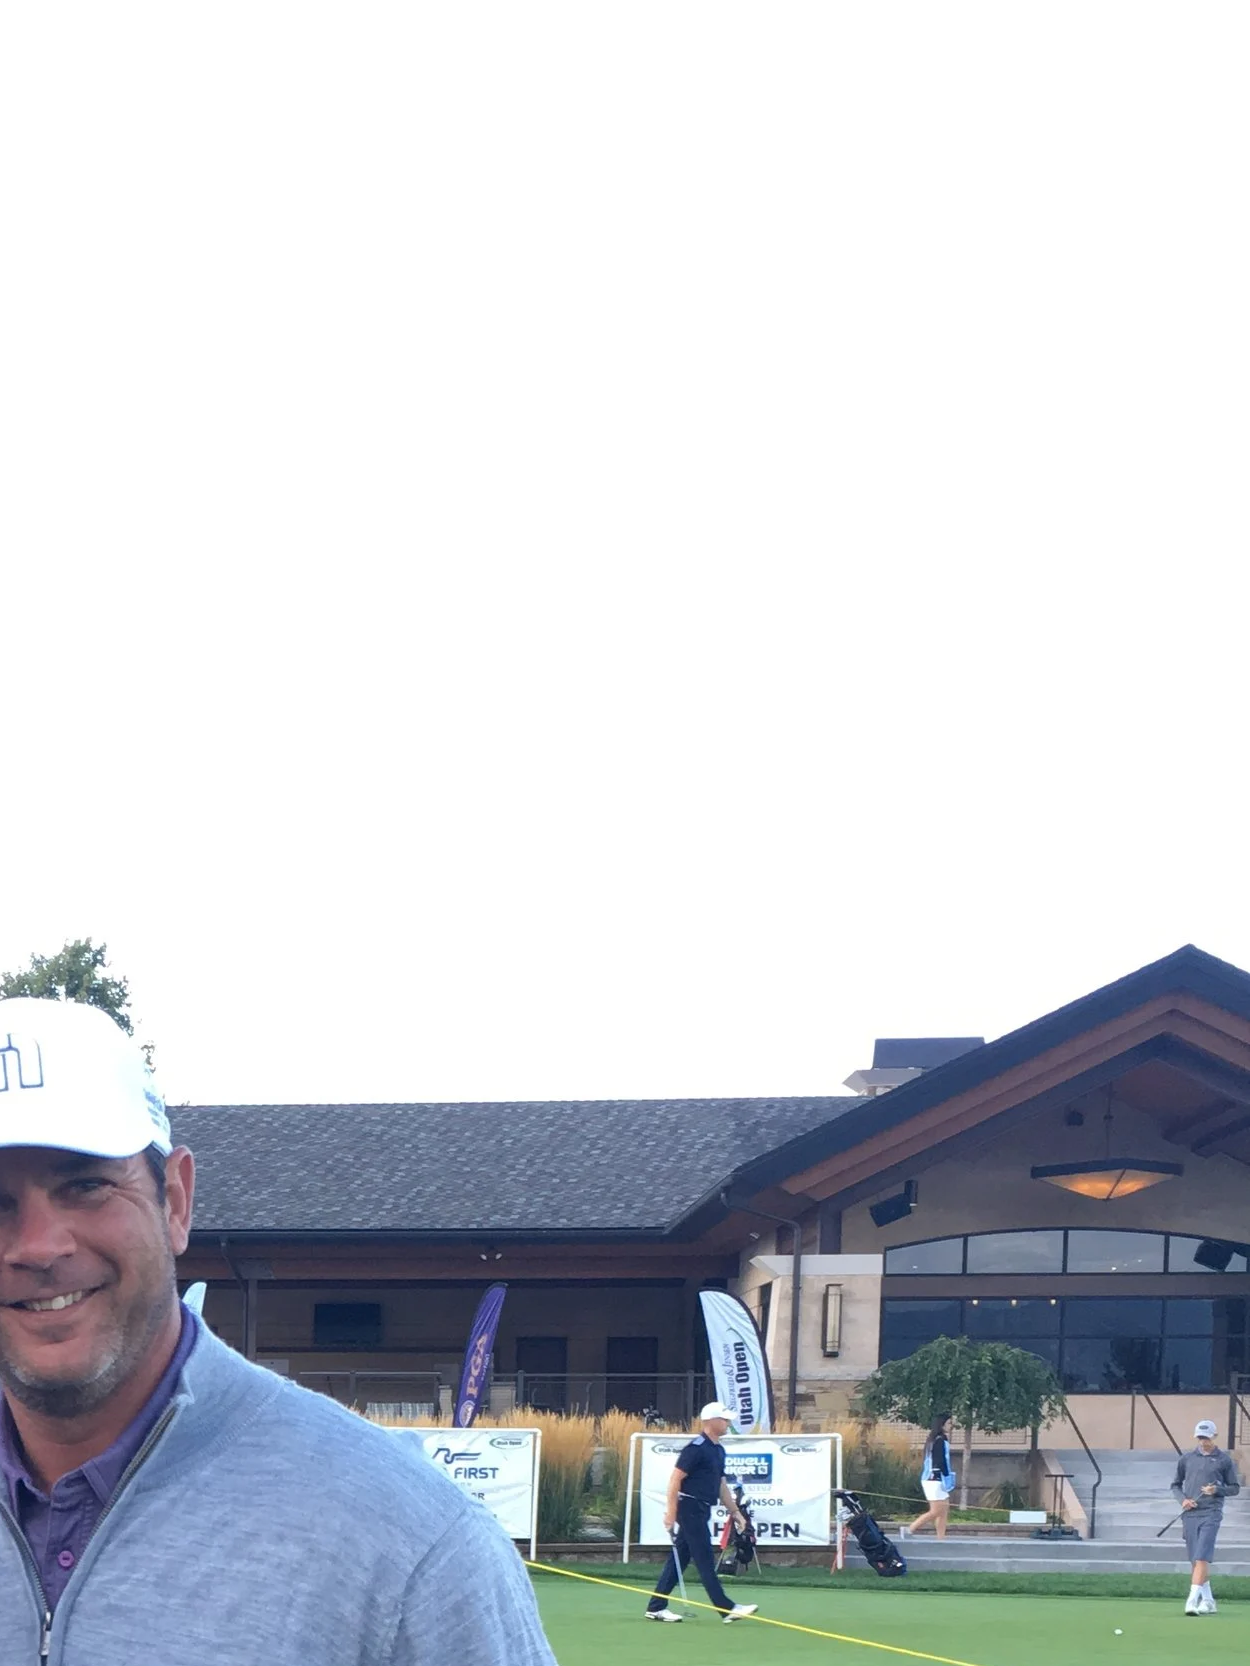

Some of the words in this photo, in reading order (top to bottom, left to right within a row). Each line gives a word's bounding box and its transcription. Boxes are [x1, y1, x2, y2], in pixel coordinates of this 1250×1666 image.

[466, 1333, 488, 1399] PGA
[733, 1341, 750, 1384] Open
[737, 1387, 755, 1426] Utah
[725, 1456, 769, 1466] DWELL
[454, 1467, 499, 1479] FIRST
[750, 1498, 784, 1507] NSOR
[756, 1522, 800, 1538] PEN
